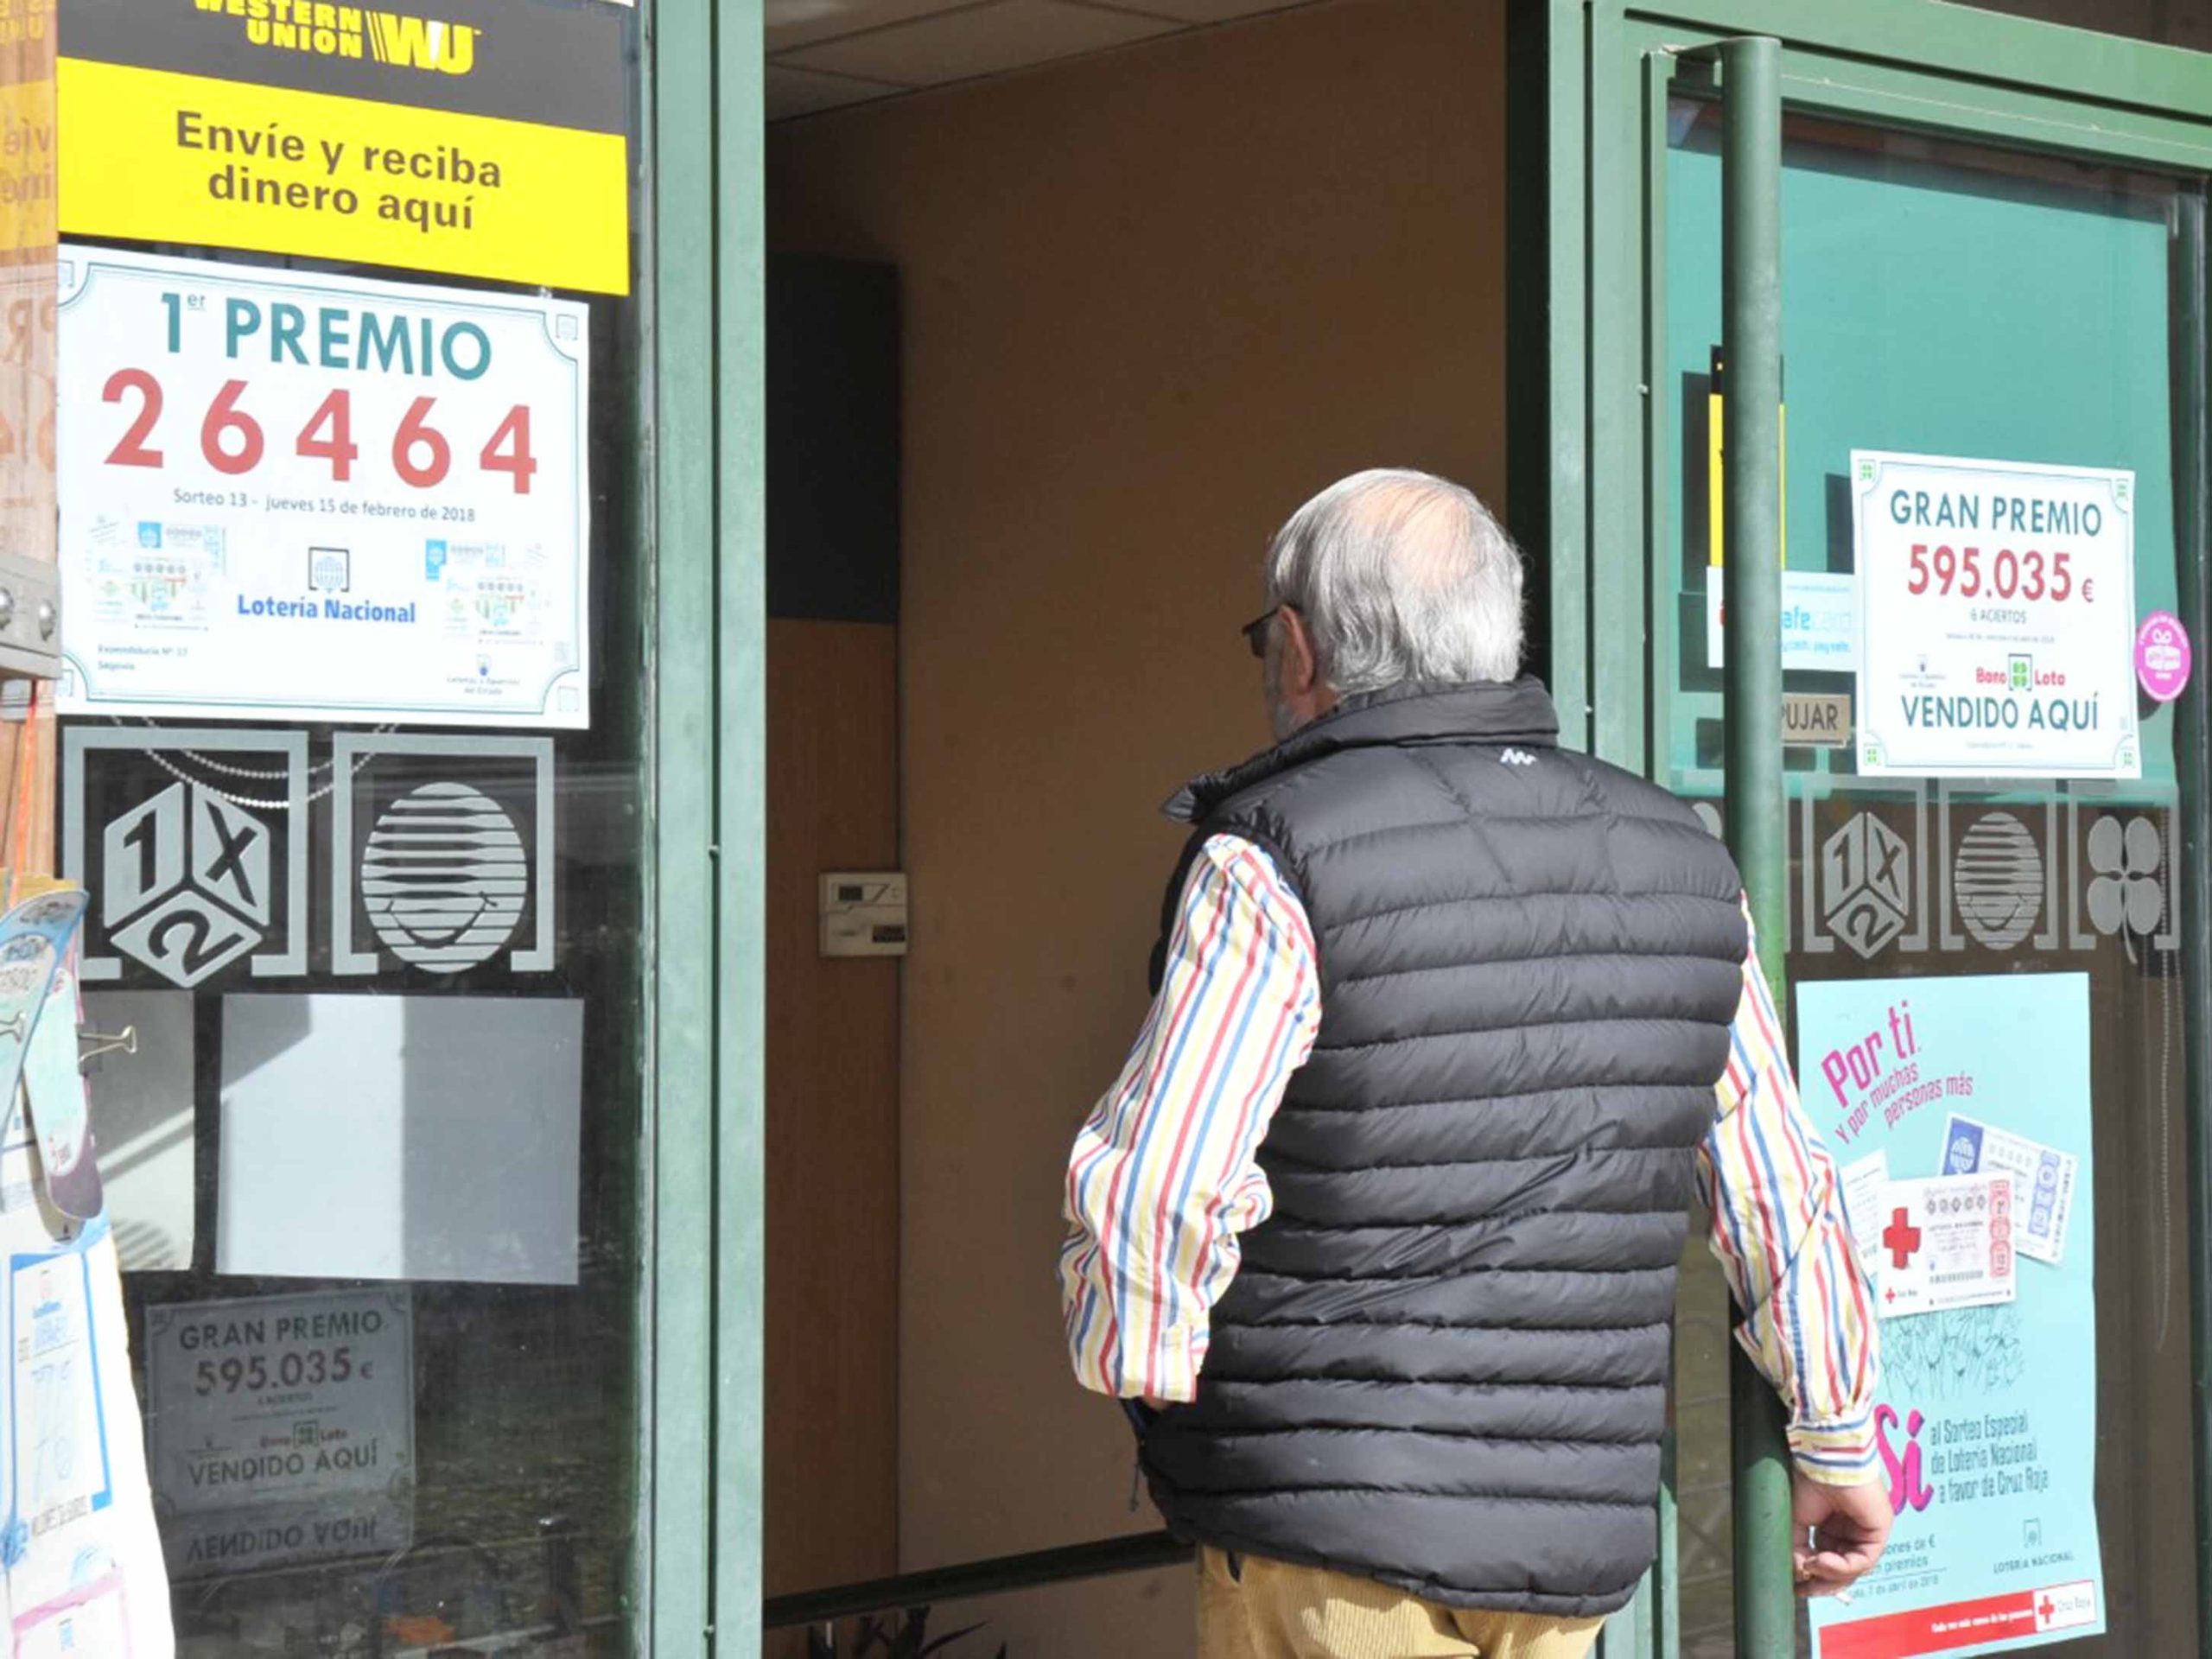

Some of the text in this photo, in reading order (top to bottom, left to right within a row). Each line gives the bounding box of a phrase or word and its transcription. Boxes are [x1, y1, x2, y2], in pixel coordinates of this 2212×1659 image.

[247, 18, 363, 59] UNION
[380, 13, 474, 75] WU
[175, 110, 501, 189] Envíe y reciba
[208, 165, 473, 233] dinero aquí
[226, 298, 492, 381] PREMIO
[174, 489, 225, 505] Sorteo
[230, 493, 247, 507] 13
[265, 495, 314, 512] jueves
[320, 498, 335, 512] 15
[340, 499, 358, 514] de
[363, 501, 416, 518] febrero
[420, 505, 437, 519] de
[442, 506, 476, 523] 2018
[1890, 489, 2101, 537] GRAN PREMIO
[1908, 543, 2094, 603] 595.035 €
[238, 594, 416, 624] Lotería Nacional
[1980, 608, 2027, 625] ACIERTOS
[1976, 666, 2066, 687] Bono Loto
[1901, 692, 2100, 731] VENDIDO AQUÍ
[1821, 1031, 1883, 1109] Por
[1847, 1100, 1869, 1138] por
[1869, 1062, 1919, 1109] muchas
[1885, 1071, 1974, 1130] personas más
[179, 1309, 383, 1351] GRAN PREMIO
[195, 1346, 353, 1397] 595.035
[1930, 1421, 1942, 1446] al
[1943, 1418, 1982, 1445] Sorteo
[1984, 1408, 2029, 1440] Especial
[188, 1452, 305, 1488] VENDIDO
[315, 1438, 378, 1473] AQUÍ
[1930, 1452, 1945, 1475] de
[1990, 1437, 2037, 1467] Nacional
[1939, 1465, 2049, 1504] a favor de Cruz Roja
[1886, 1541, 1911, 1555] ones
